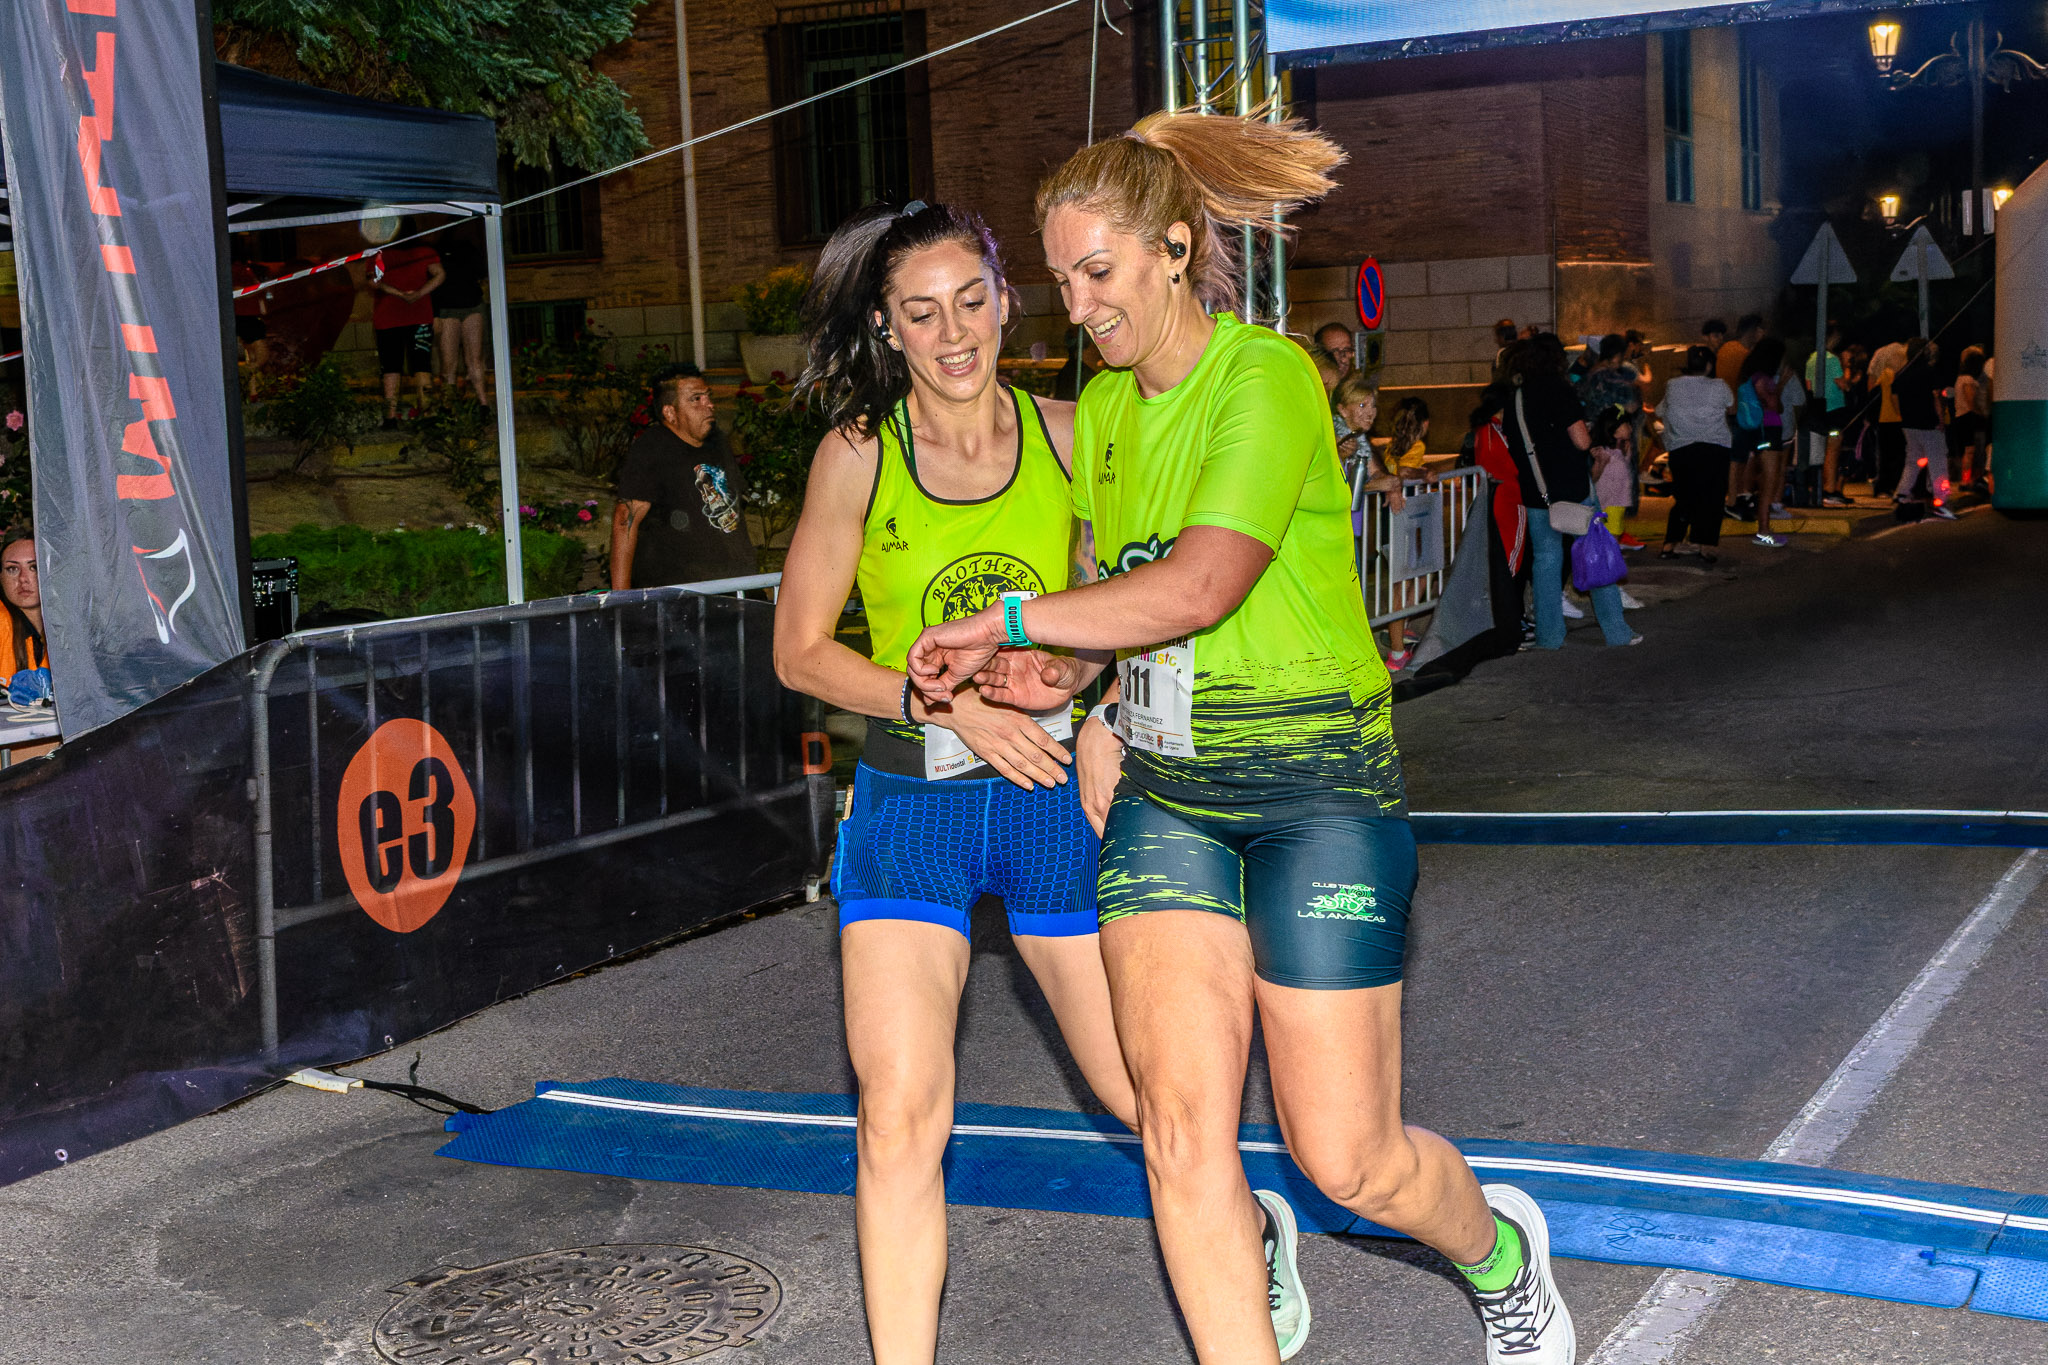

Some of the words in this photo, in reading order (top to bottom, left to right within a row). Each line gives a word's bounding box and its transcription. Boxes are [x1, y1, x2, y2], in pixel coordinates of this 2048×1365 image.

[881, 541, 909, 552] AIMAR
[932, 557, 1037, 603] BROTHERS
[1125, 661, 1150, 708] 311
[358, 756, 455, 895] e3
[1338, 883, 1375, 892] TRIATLON
[1297, 910, 1326, 919] LAS
[1327, 912, 1386, 922] AMERICAS
